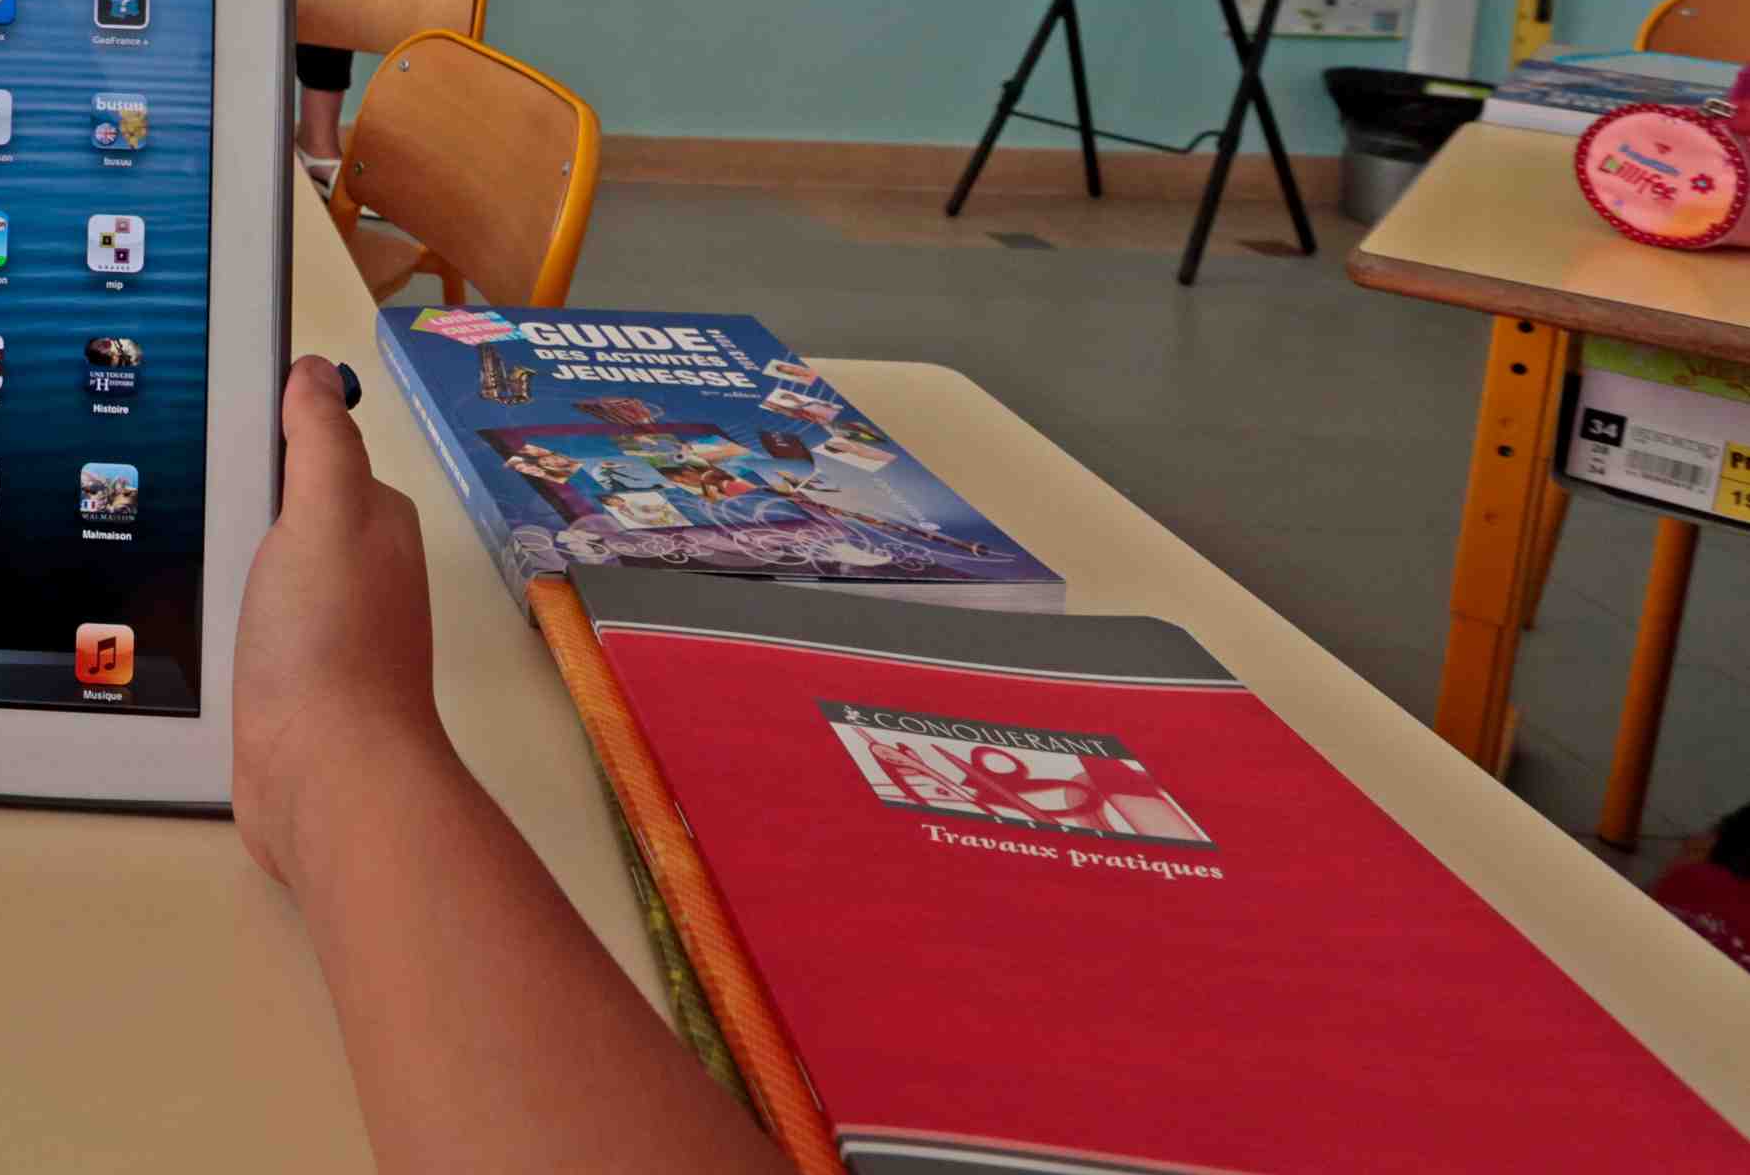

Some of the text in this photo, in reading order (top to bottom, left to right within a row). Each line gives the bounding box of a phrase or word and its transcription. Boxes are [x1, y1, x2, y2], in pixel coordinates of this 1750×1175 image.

[95, 96, 146, 112] busuu
[104, 156, 133, 168] busuu
[105, 279, 124, 291] mip
[518, 321, 718, 352] GUIDE
[534, 348, 729, 368] DES ACTIVITÉS
[551, 364, 758, 389] JEUNESSE
[92, 403, 130, 415] Histoire
[1587, 418, 1618, 438] 34
[81, 529, 133, 542] Malmaison
[83, 689, 124, 703] Musique
[872, 712, 1110, 757] CONQUERANT
[921, 823, 1225, 881] Travaux pratiques
